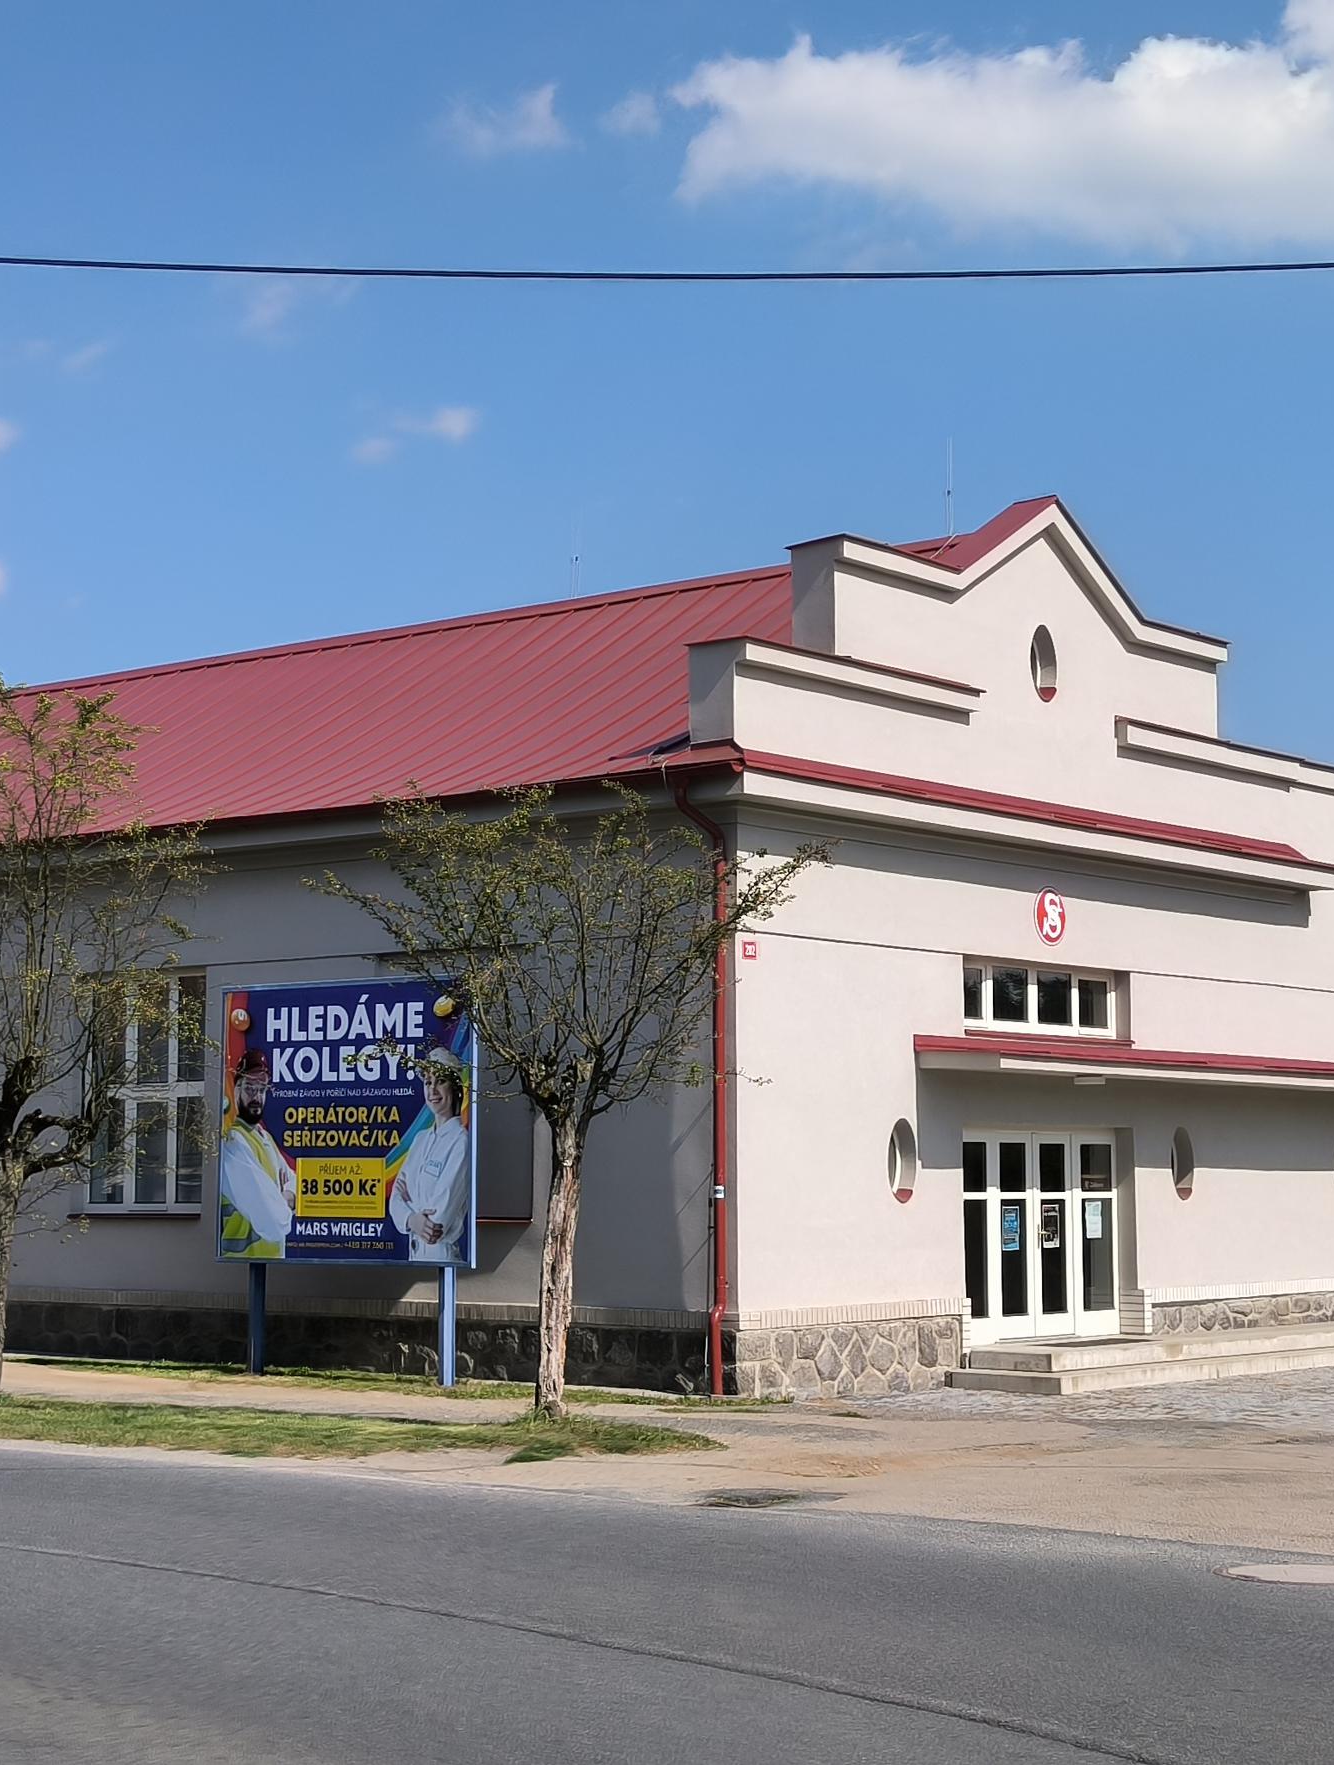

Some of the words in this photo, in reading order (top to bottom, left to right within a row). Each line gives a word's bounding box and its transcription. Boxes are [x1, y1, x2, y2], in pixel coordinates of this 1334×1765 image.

[267, 994, 424, 1042] HLEDÁME
[272, 1044, 416, 1083] KOLEGY!
[347, 1088, 362, 1097] NAD
[284, 1102, 400, 1124] OPERÁTOR/KA
[283, 1126, 400, 1147] SEŘIZOVAČ/KA
[319, 1163, 347, 1175] PŘÍJEM
[301, 1179, 318, 1195] 38
[323, 1179, 354, 1195] 500
[296, 1222, 328, 1236] MARS
[331, 1222, 384, 1237] WRIGLEY
